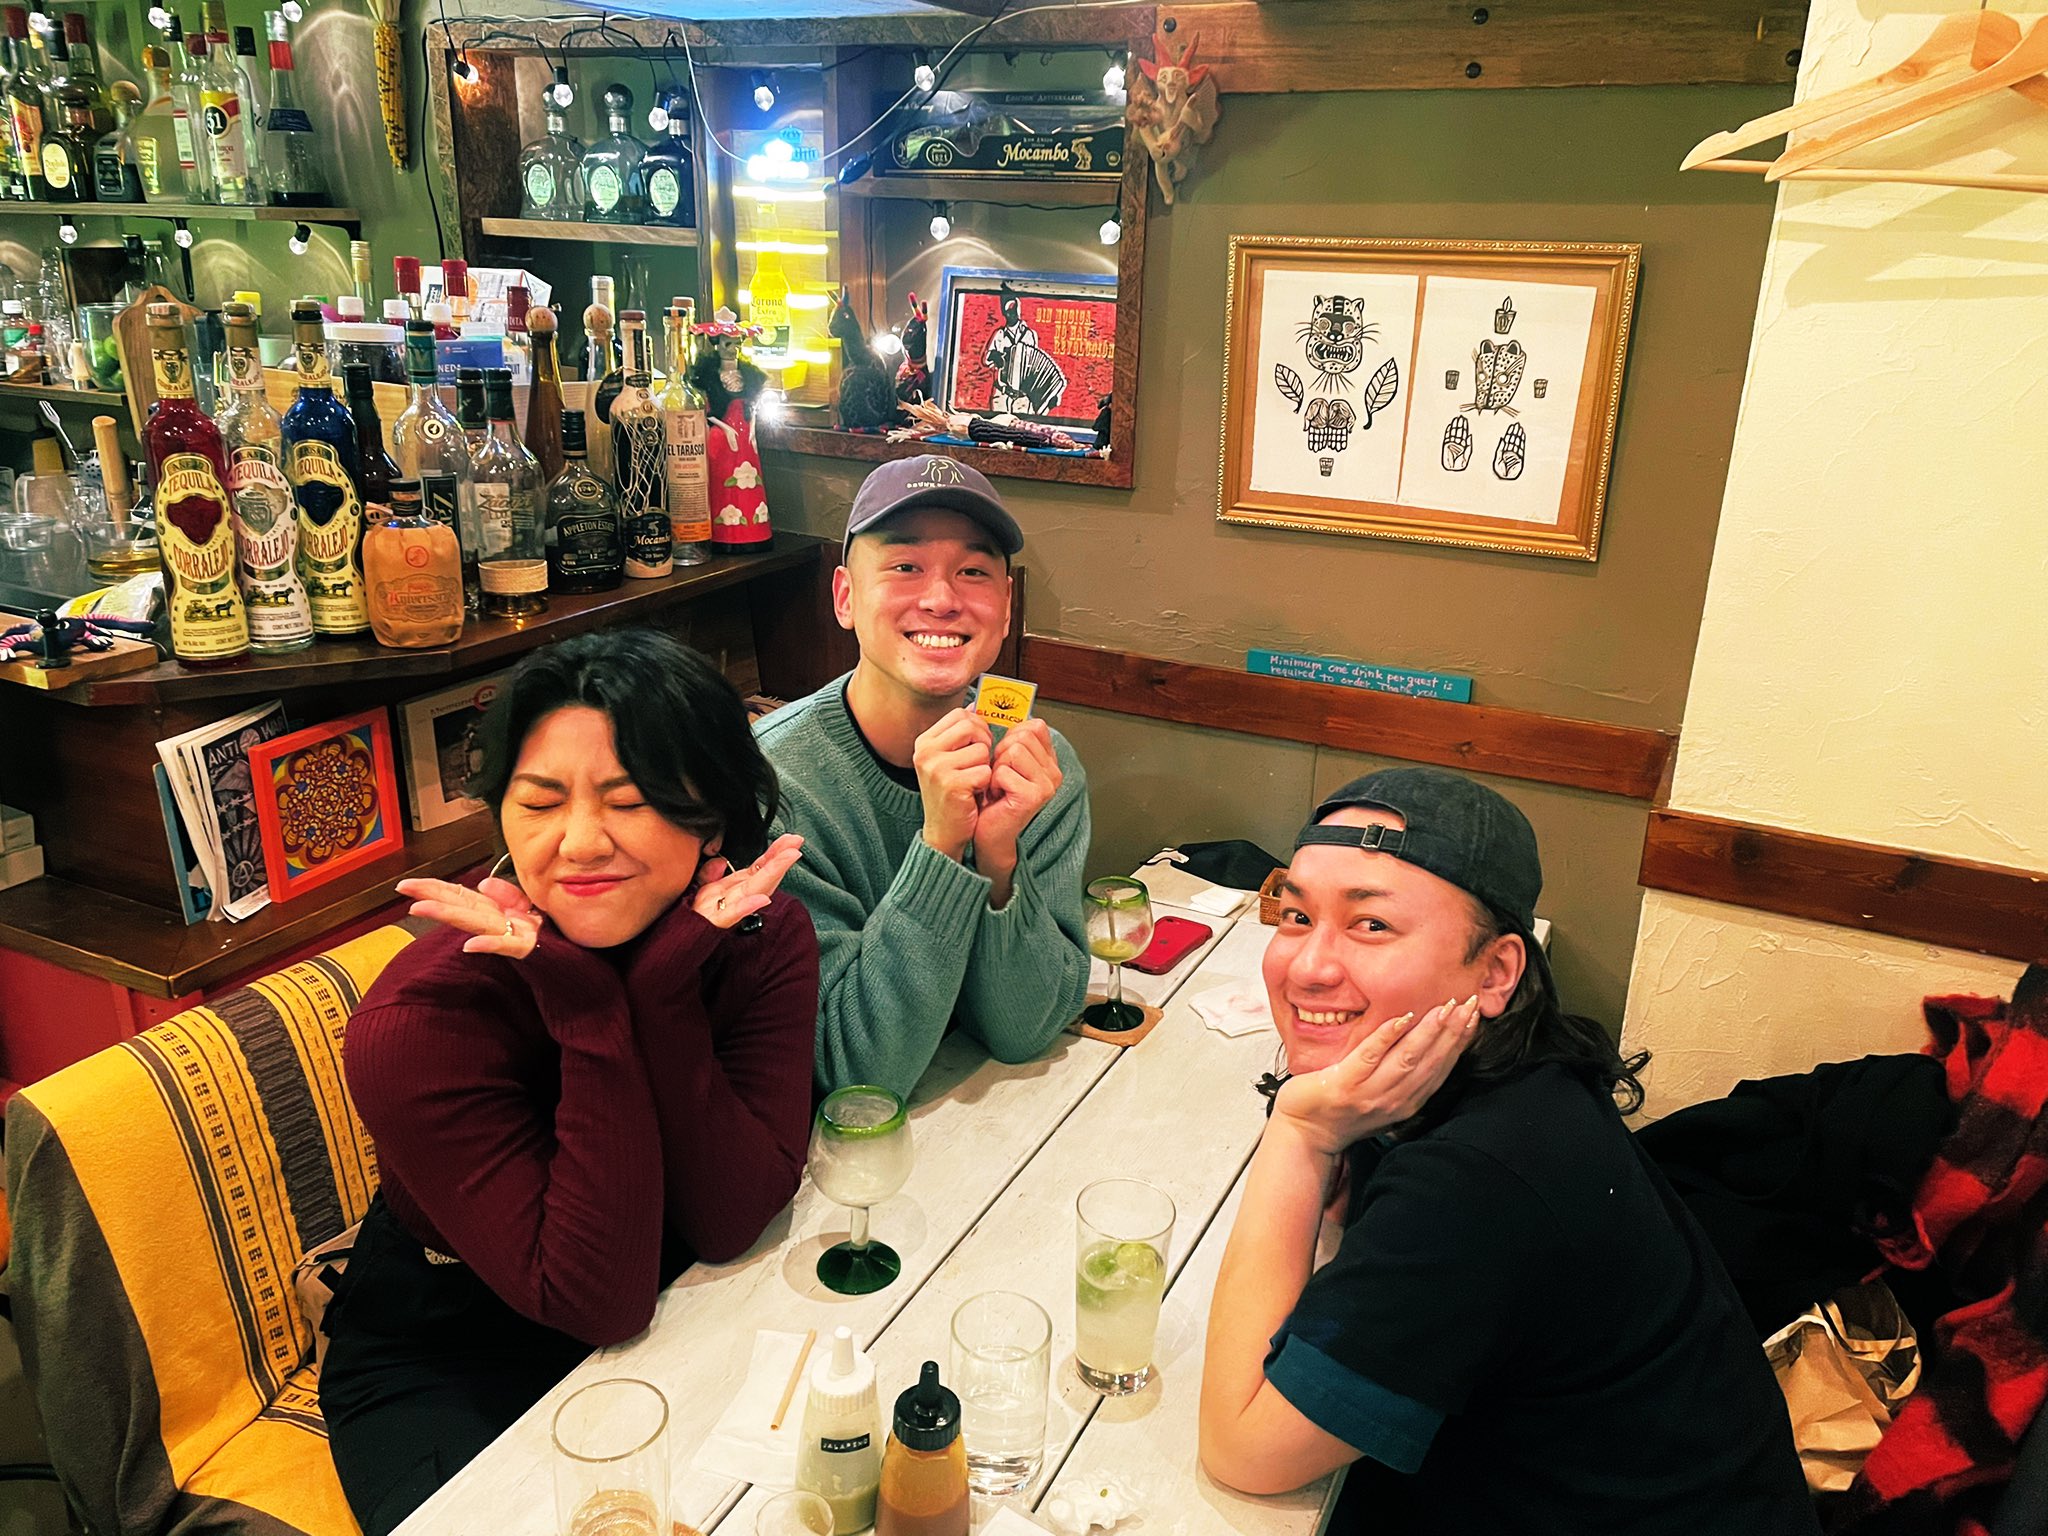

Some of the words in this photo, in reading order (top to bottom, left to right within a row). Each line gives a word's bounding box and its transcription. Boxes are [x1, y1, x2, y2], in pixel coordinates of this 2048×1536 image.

[206, 112, 223, 130] 51
[751, 295, 783, 308] Corona
[1035, 307, 1053, 323] SIN
[1053, 324, 1067, 340] NO
[1069, 325, 1091, 341] HAY
[168, 471, 217, 496] TEQUILA
[563, 521, 599, 538] APPLETON
[173, 540, 229, 580] CORRALEJO
[1270, 655, 1322, 670] Minimum
[1328, 664, 1349, 674] one
[1351, 666, 1384, 680] drink
[1387, 673, 1405, 684] per
[1406, 676, 1438, 688] guest
[1443, 680, 1454, 691] is
[1270, 666, 1316, 679] required
[1319, 673, 1335, 683] to
[207, 739, 241, 769] ANTI
